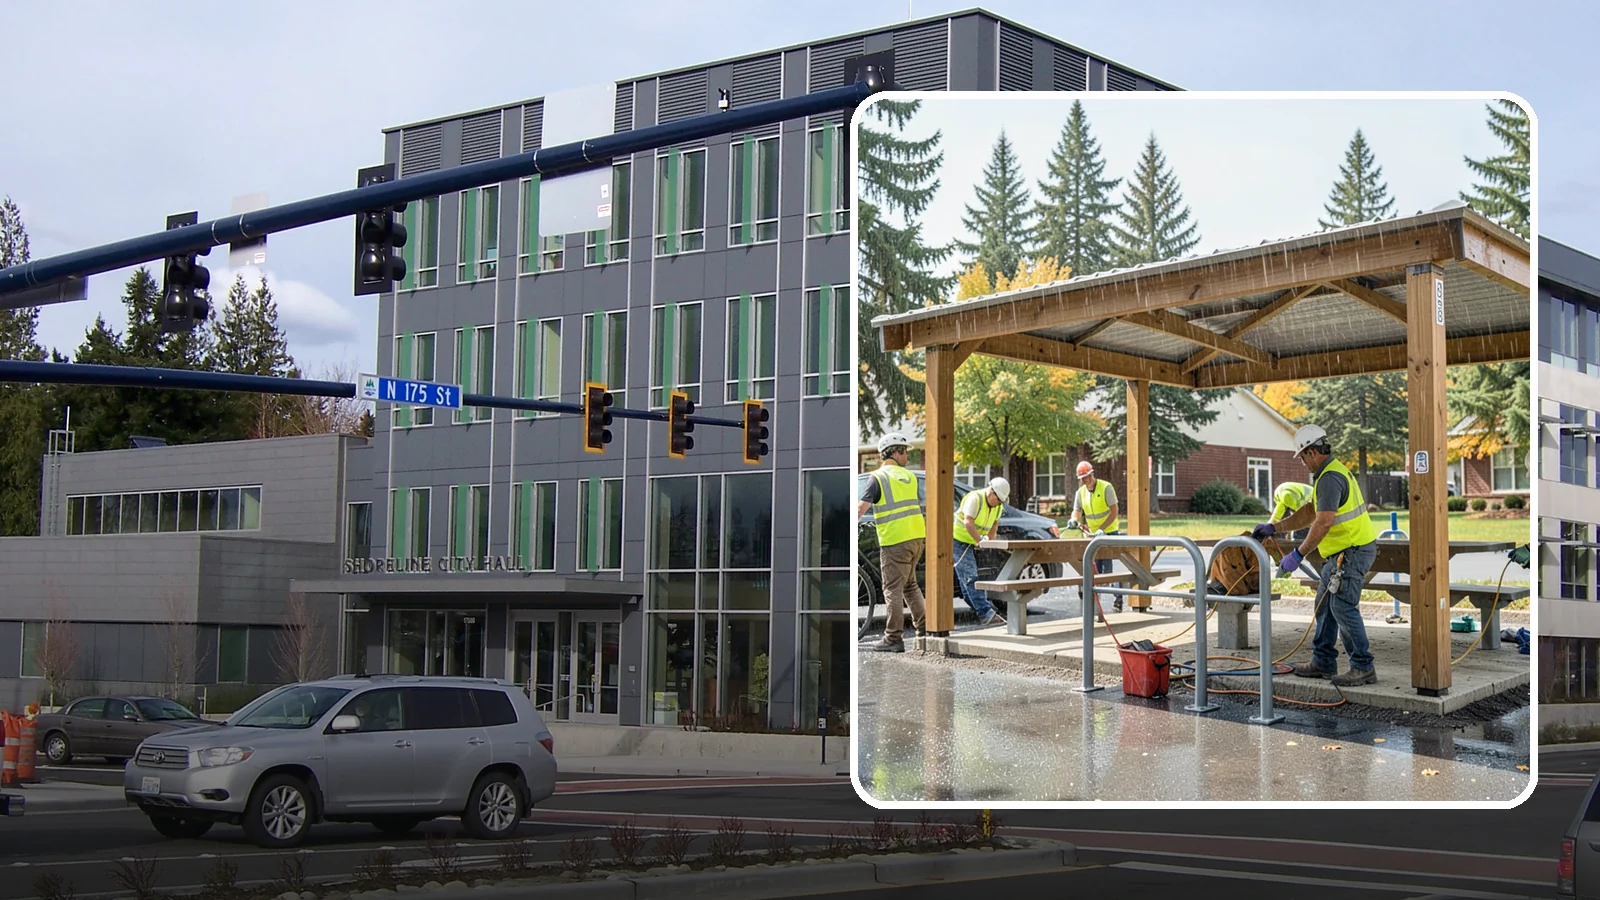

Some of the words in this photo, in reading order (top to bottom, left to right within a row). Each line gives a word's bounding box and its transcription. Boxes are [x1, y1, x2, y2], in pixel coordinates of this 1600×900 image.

[387, 380, 396, 400] N
[405, 382, 427, 403] 175
[436, 386, 451, 406] St
[343, 556, 432, 574] SHORELINE
[438, 556, 476, 572] CITY
[484, 555, 526, 572] HALL
